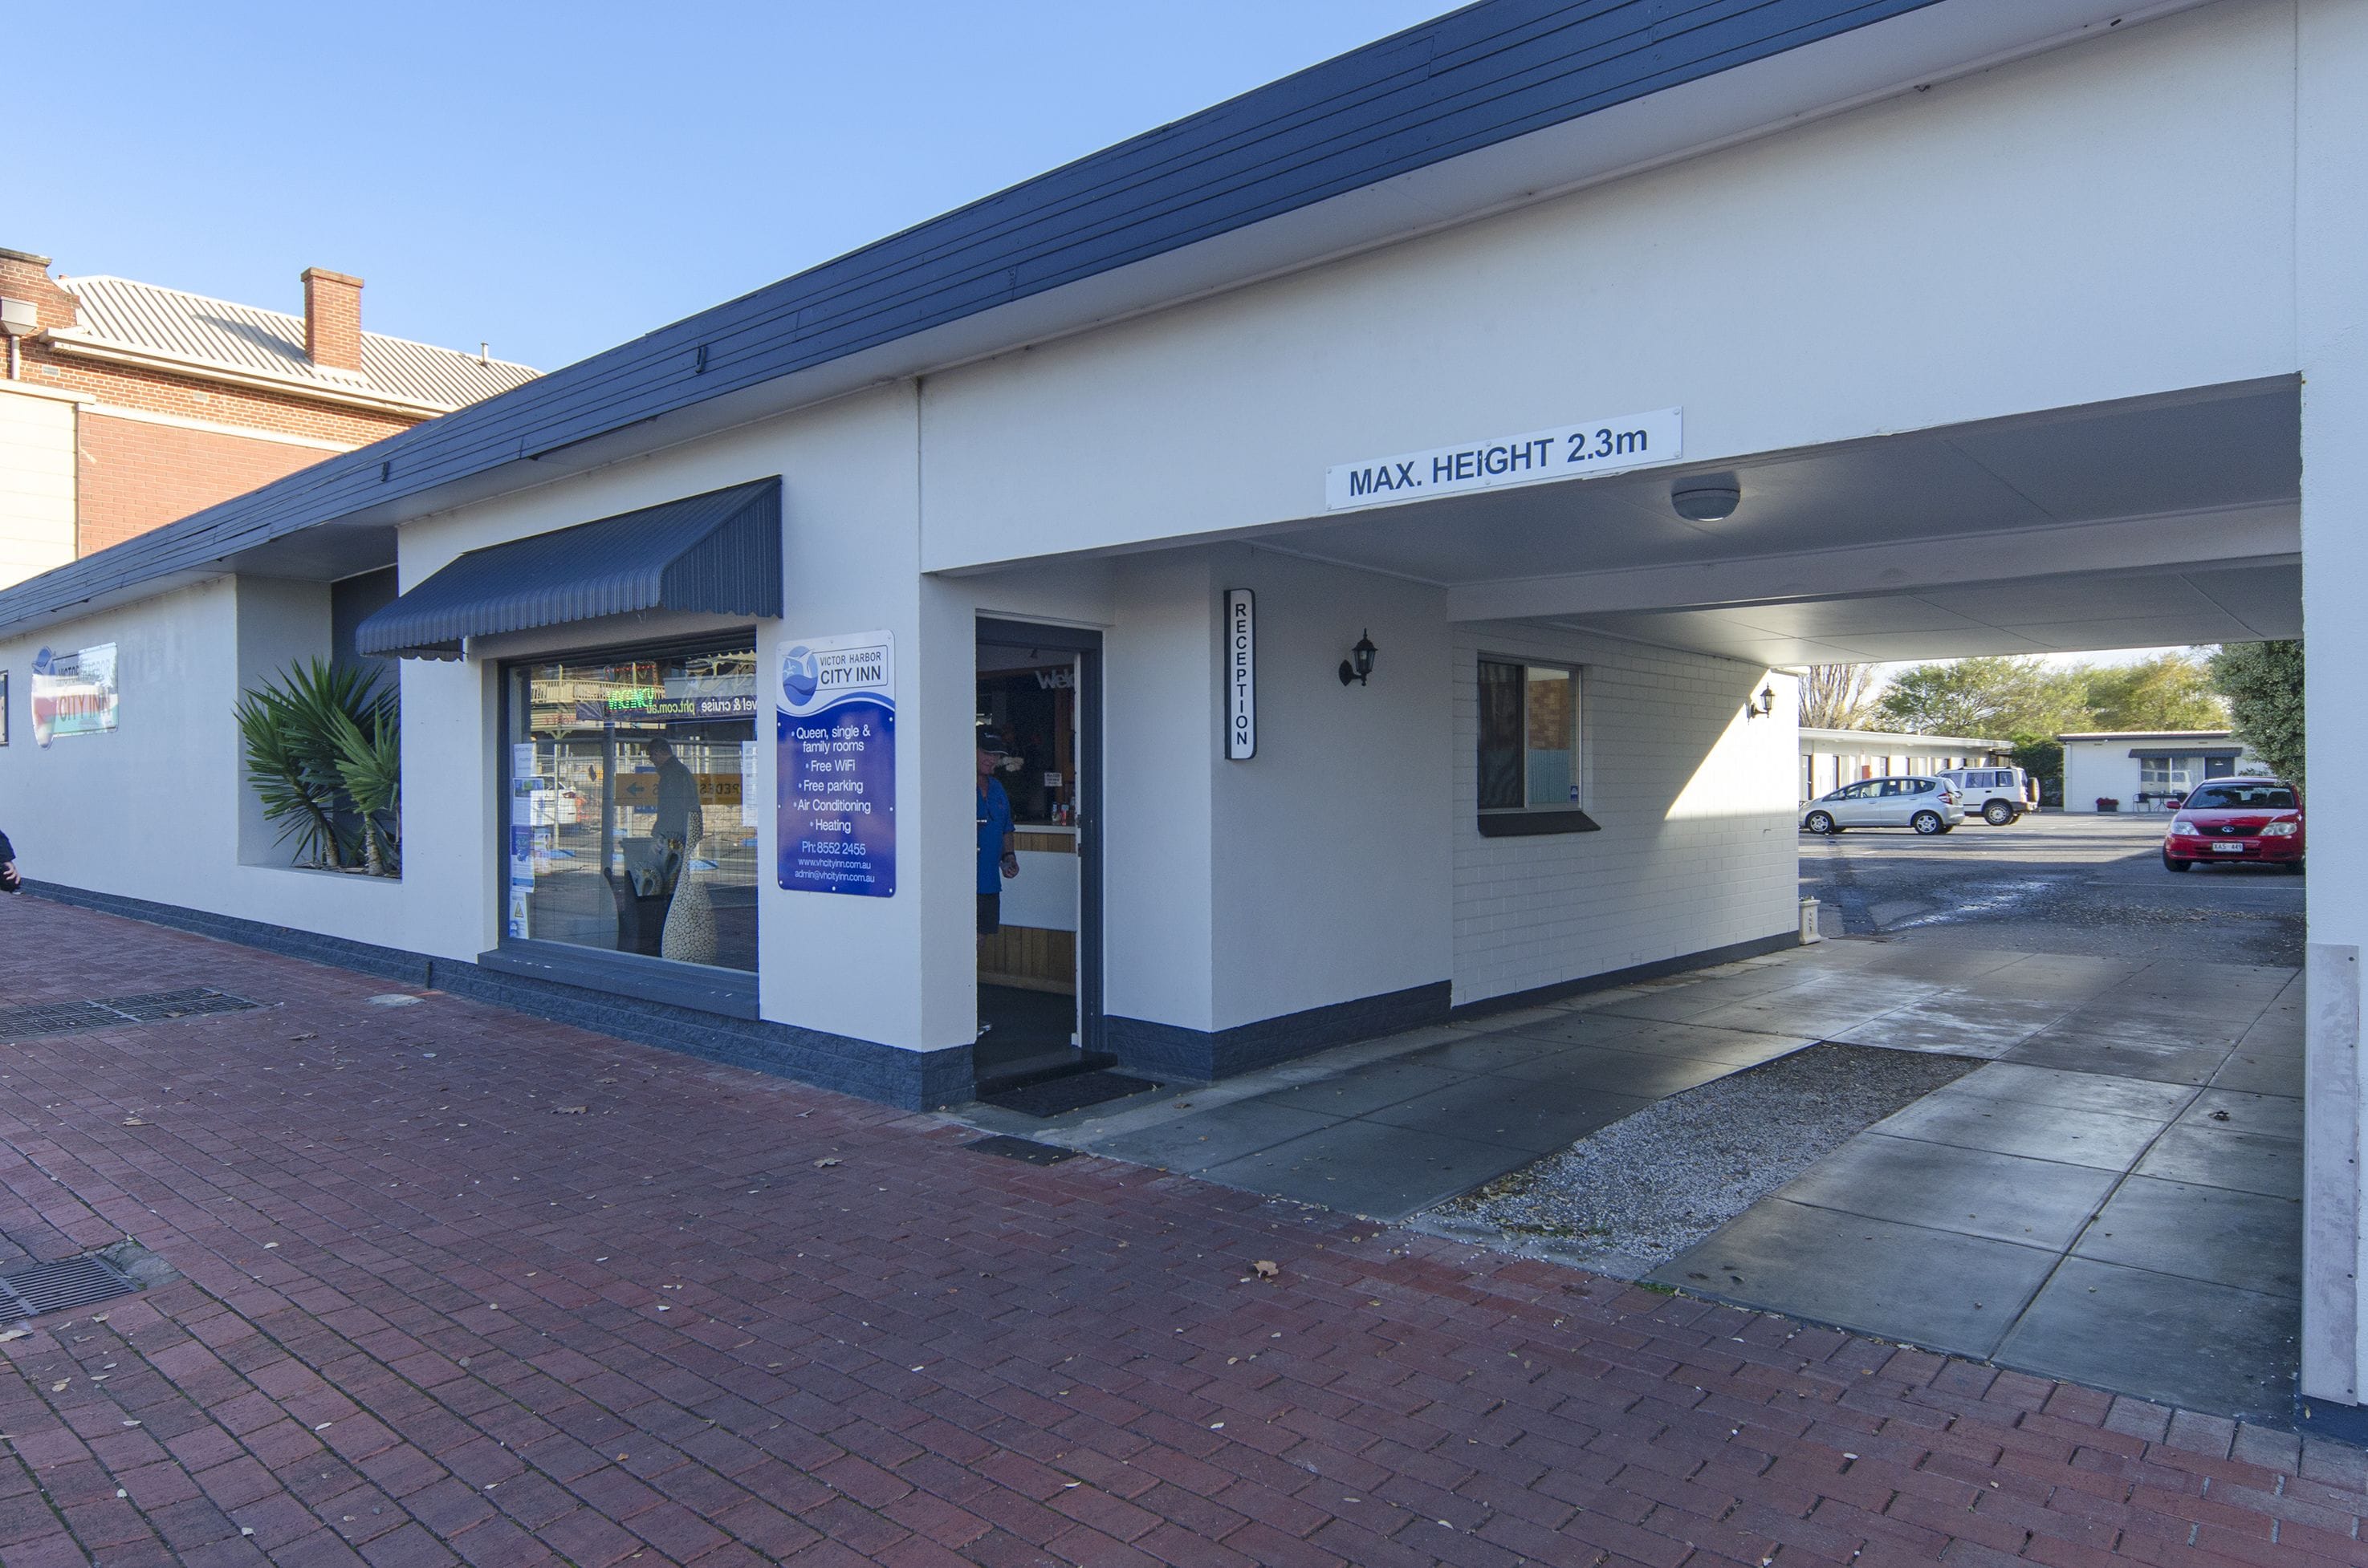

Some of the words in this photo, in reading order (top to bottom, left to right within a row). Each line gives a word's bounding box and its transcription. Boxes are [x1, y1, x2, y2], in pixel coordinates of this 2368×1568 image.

[1349, 461, 1422, 497] MAX.
[1432, 437, 1555, 484] HEIGHT
[1566, 428, 1648, 464] 2.3m
[820, 655, 846, 666] VICTOR
[849, 651, 881, 664] HARBOR
[820, 668, 852, 684] CITY
[856, 665, 881, 682] INN
[1235, 603, 1248, 745] RECEPTION
[59, 693, 85, 722] CITY
[796, 726, 828, 740] Queen,
[832, 725, 860, 741] single
[862, 724, 871, 737] &
[803, 741, 830, 754] family
[832, 741, 865, 753] rooms
[811, 760, 832, 772] Free
[835, 759, 856, 772] WiFi
[804, 780, 824, 791] Free
[828, 779, 864, 794] parking
[797, 799, 811, 811] Air
[812, 798, 872, 814] Conditioning
[815, 819, 851, 834] Heating
[842, 843, 866, 855] 2455
[798, 857, 871, 871] www.vhcityinn.com.au
[795, 870, 875, 883] admin@vhcityinn.com.au
